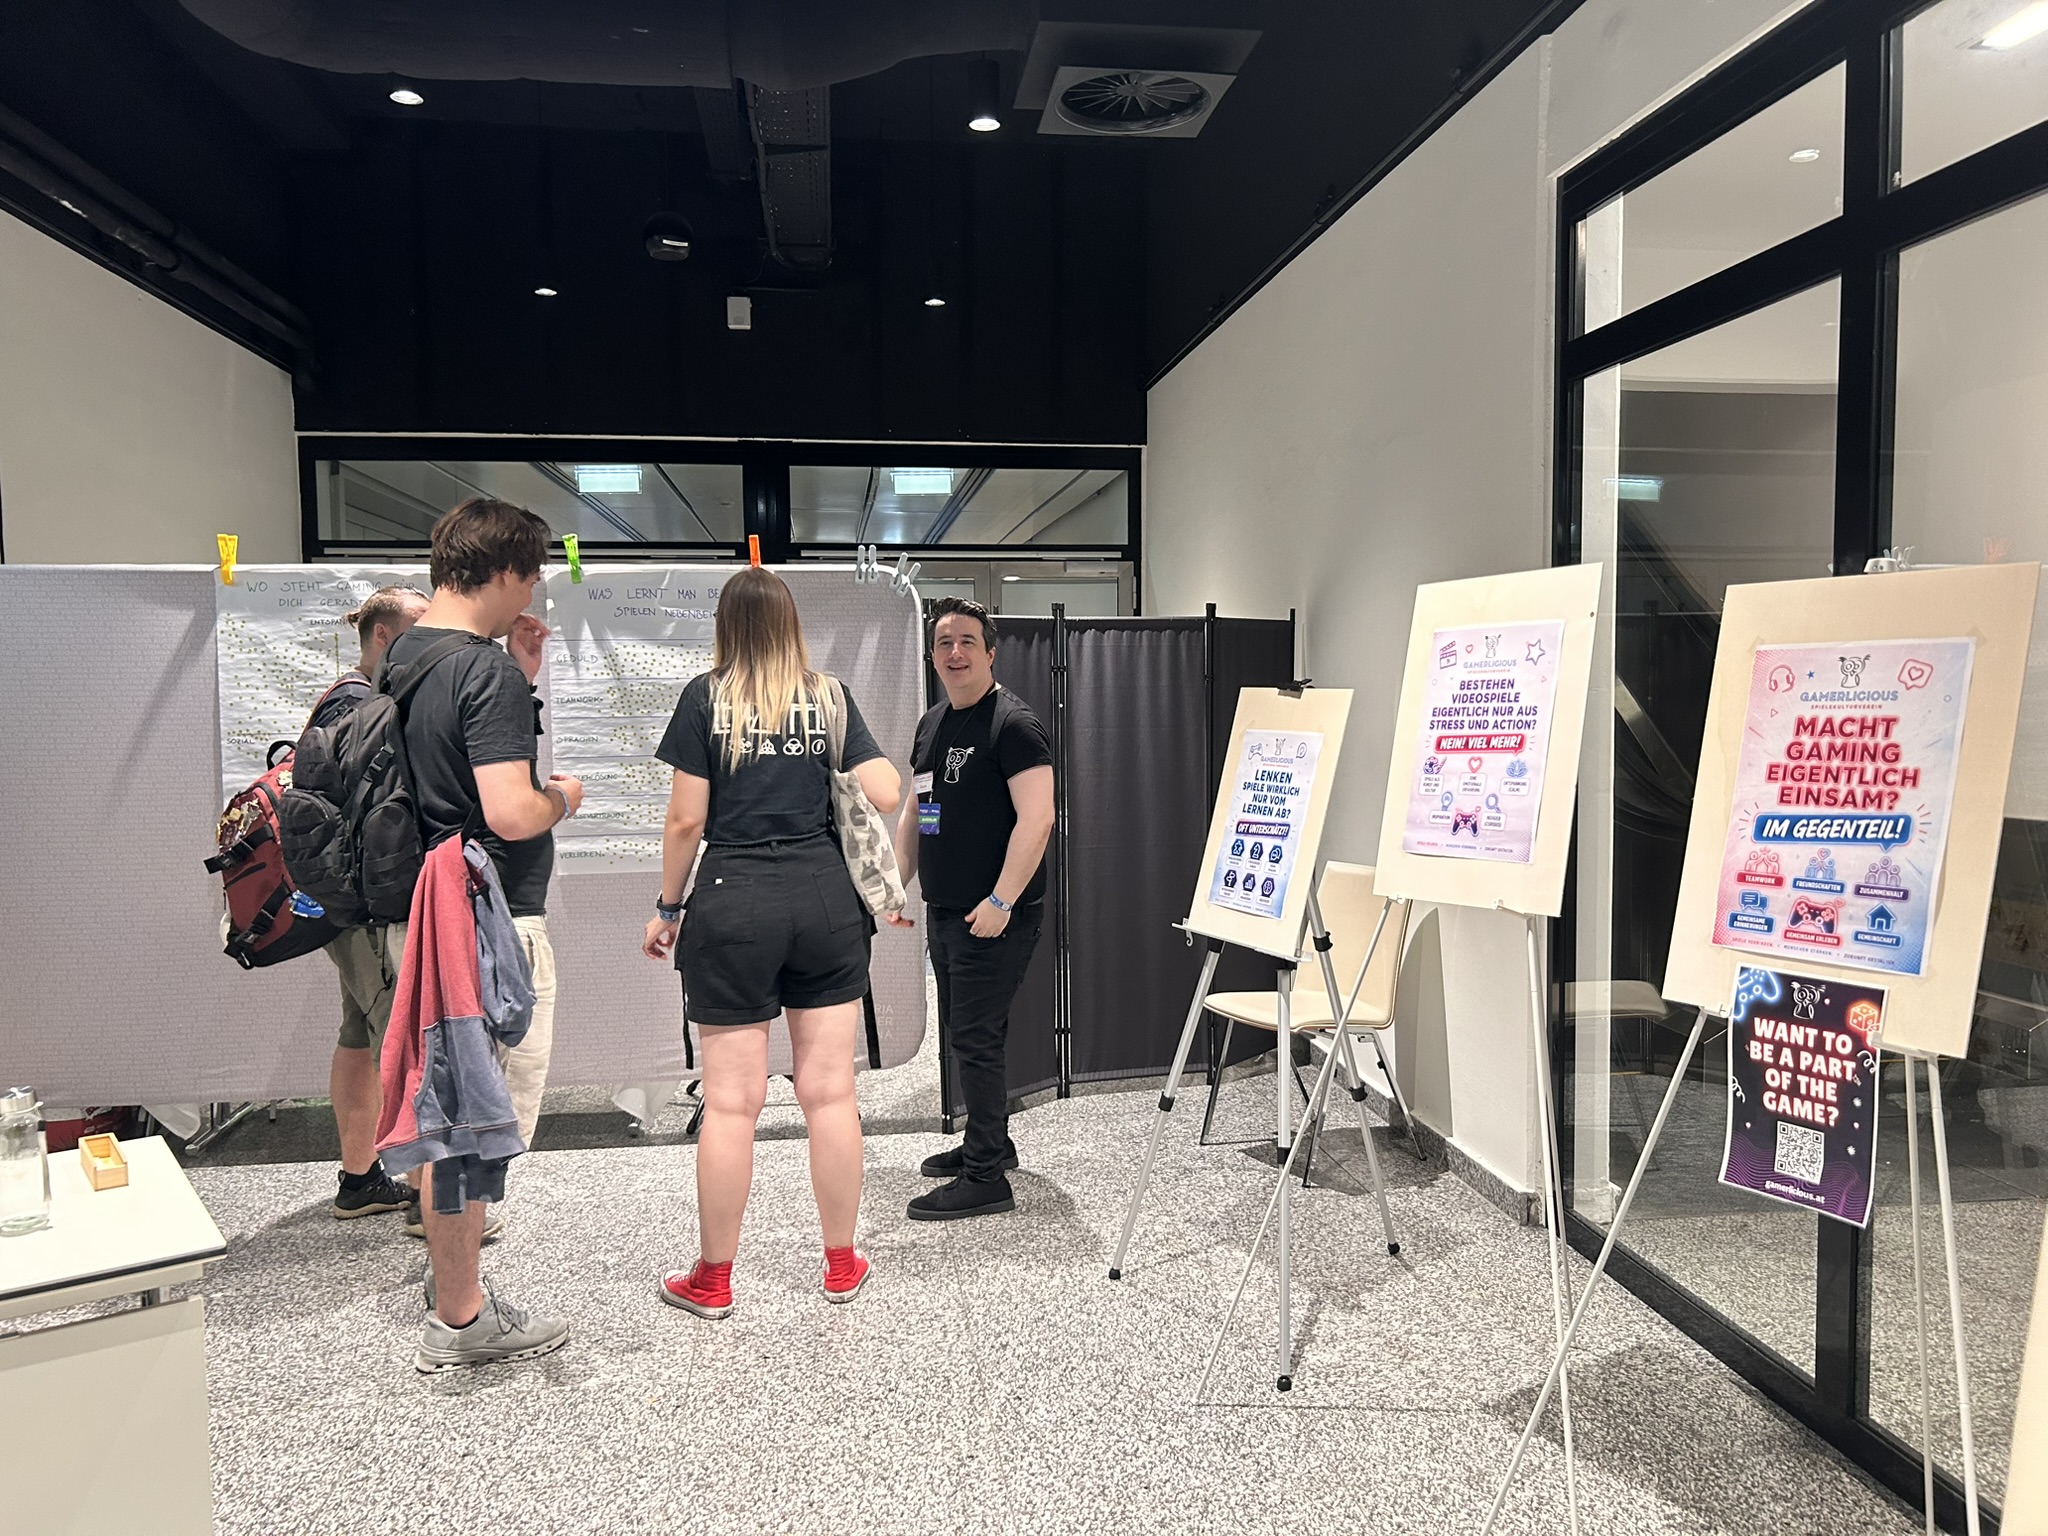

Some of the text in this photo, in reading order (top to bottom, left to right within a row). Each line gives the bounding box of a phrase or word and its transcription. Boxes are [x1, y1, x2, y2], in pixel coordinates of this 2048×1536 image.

[247, 581, 267, 592] WO
[281, 581, 324, 592] STEHT
[337, 581, 382, 592] GAMING
[588, 588, 719, 600] WAS LERNT MAN BE
[279, 598, 303, 607] DICH
[614, 607, 656, 618] SPIELEN
[556, 653, 598, 664] GEDULD
[1459, 679, 1515, 690] BESTEHEN
[1451, 692, 1521, 704] VIDEOSPIELE
[1800, 690, 1899, 702] GAMERLICIOUS
[1432, 705, 1538, 718] EIGENTLICH NUR AUS
[1429, 719, 1537, 731] STRESS UND ACTION?
[1795, 716, 1898, 738] MACHT
[1440, 735, 1520, 749] NEIN! VIEL MEHR!
[1786, 741, 1900, 764] GAMING
[1254, 769, 1293, 784] LENKEN
[1766, 763, 1920, 788] EIGENTLICH
[1242, 781, 1300, 797] SPIELE WIRKLICH
[1252, 793, 1287, 806] NUR VOM
[1778, 786, 1900, 811] EINSAM?
[1242, 803, 1291, 819] LERNEN AB?
[1237, 823, 1248, 833] OFT
[1762, 818, 1904, 840] IM GEGENTEIL!
[1744, 874, 1776, 885] TEAMWORK
[1795, 880, 1842, 891] FREUNDSCHAFTEN
[1859, 888, 1904, 898] ZUSAMMENHALT
[1753, 1016, 1852, 1055] WANT TO
[1749, 1039, 1856, 1081] BE A PART
[1765, 1068, 1838, 1102] OF THE
[1762, 1091, 1840, 1127] GAME?
[1764, 1179, 1825, 1204] gamerlicious.at
